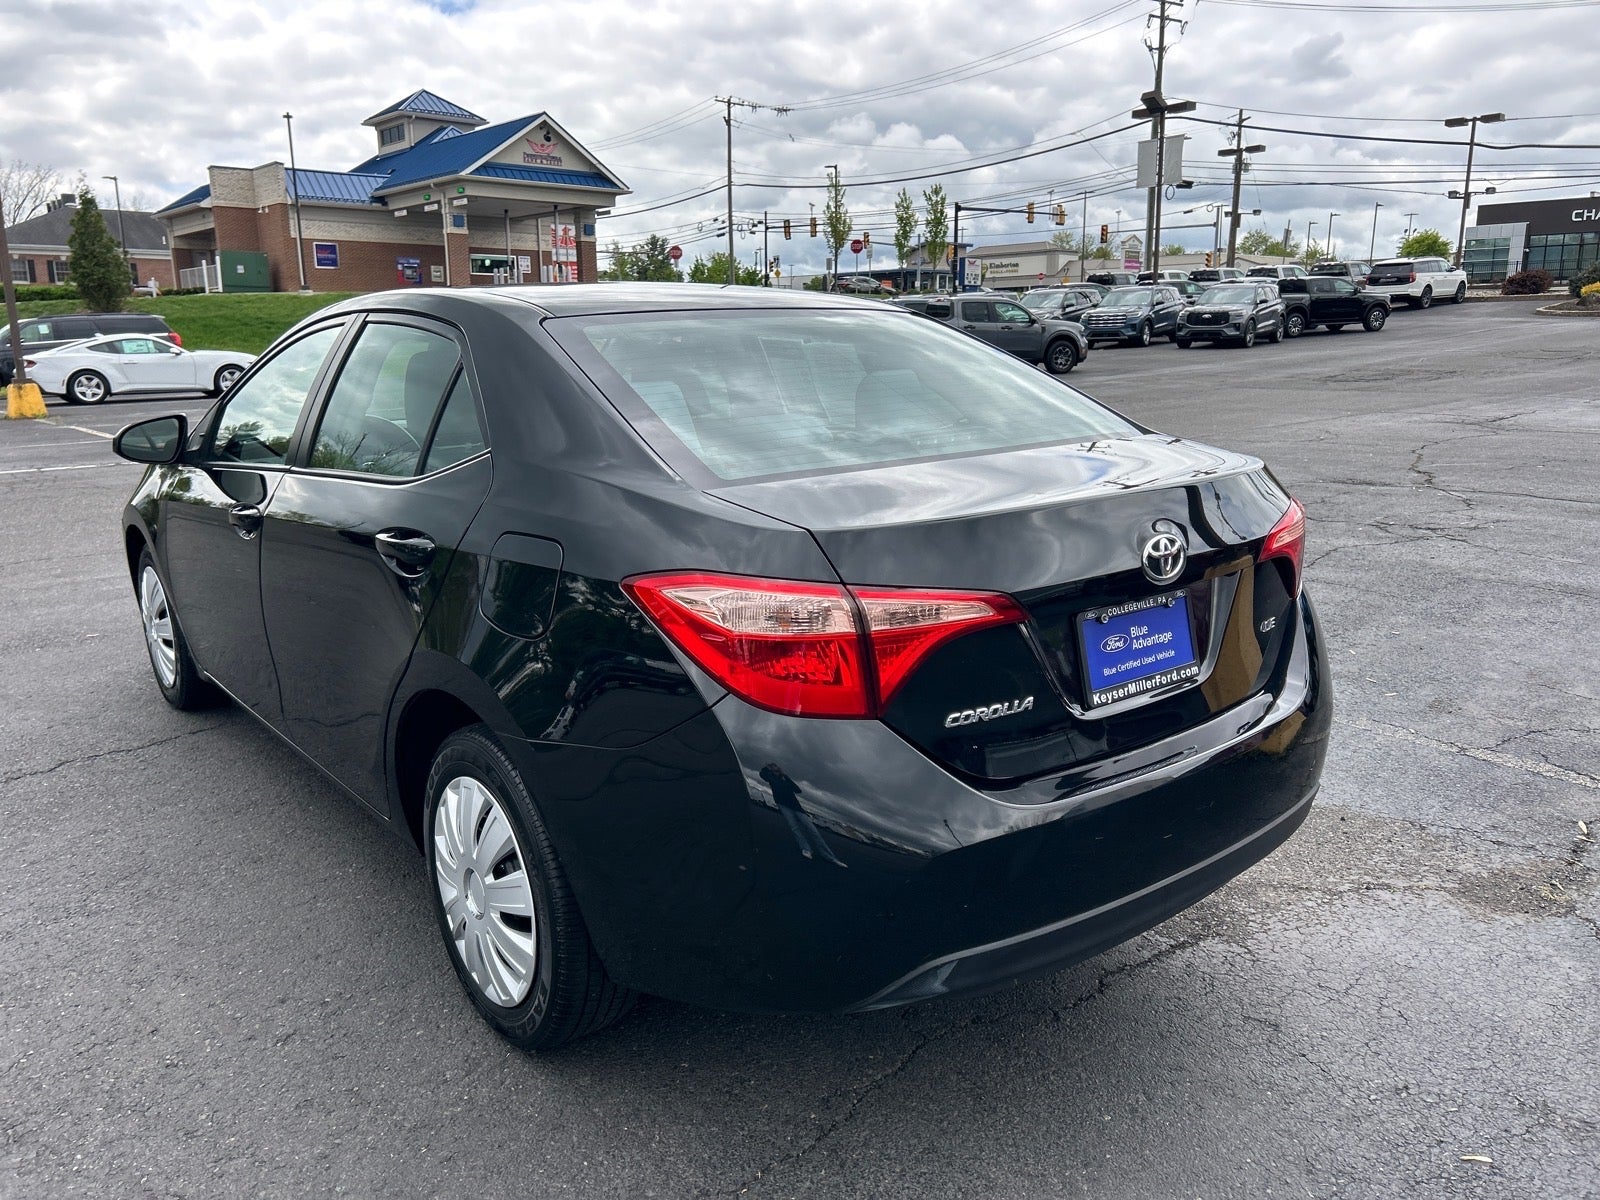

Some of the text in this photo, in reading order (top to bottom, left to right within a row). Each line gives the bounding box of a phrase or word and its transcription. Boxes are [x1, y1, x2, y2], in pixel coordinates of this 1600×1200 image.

[1107, 596, 1167, 617] COLLEGEVILLE, PA
[1130, 625, 1148, 638] Blue
[1132, 631, 1173, 650] Advantage
[1105, 636, 1125, 651] Ford
[1103, 649, 1176, 677] Blue Certified Used Vehicle
[1092, 665, 1199, 705] KeyserMillerFord.com
[944, 696, 1034, 728] COROLLA
